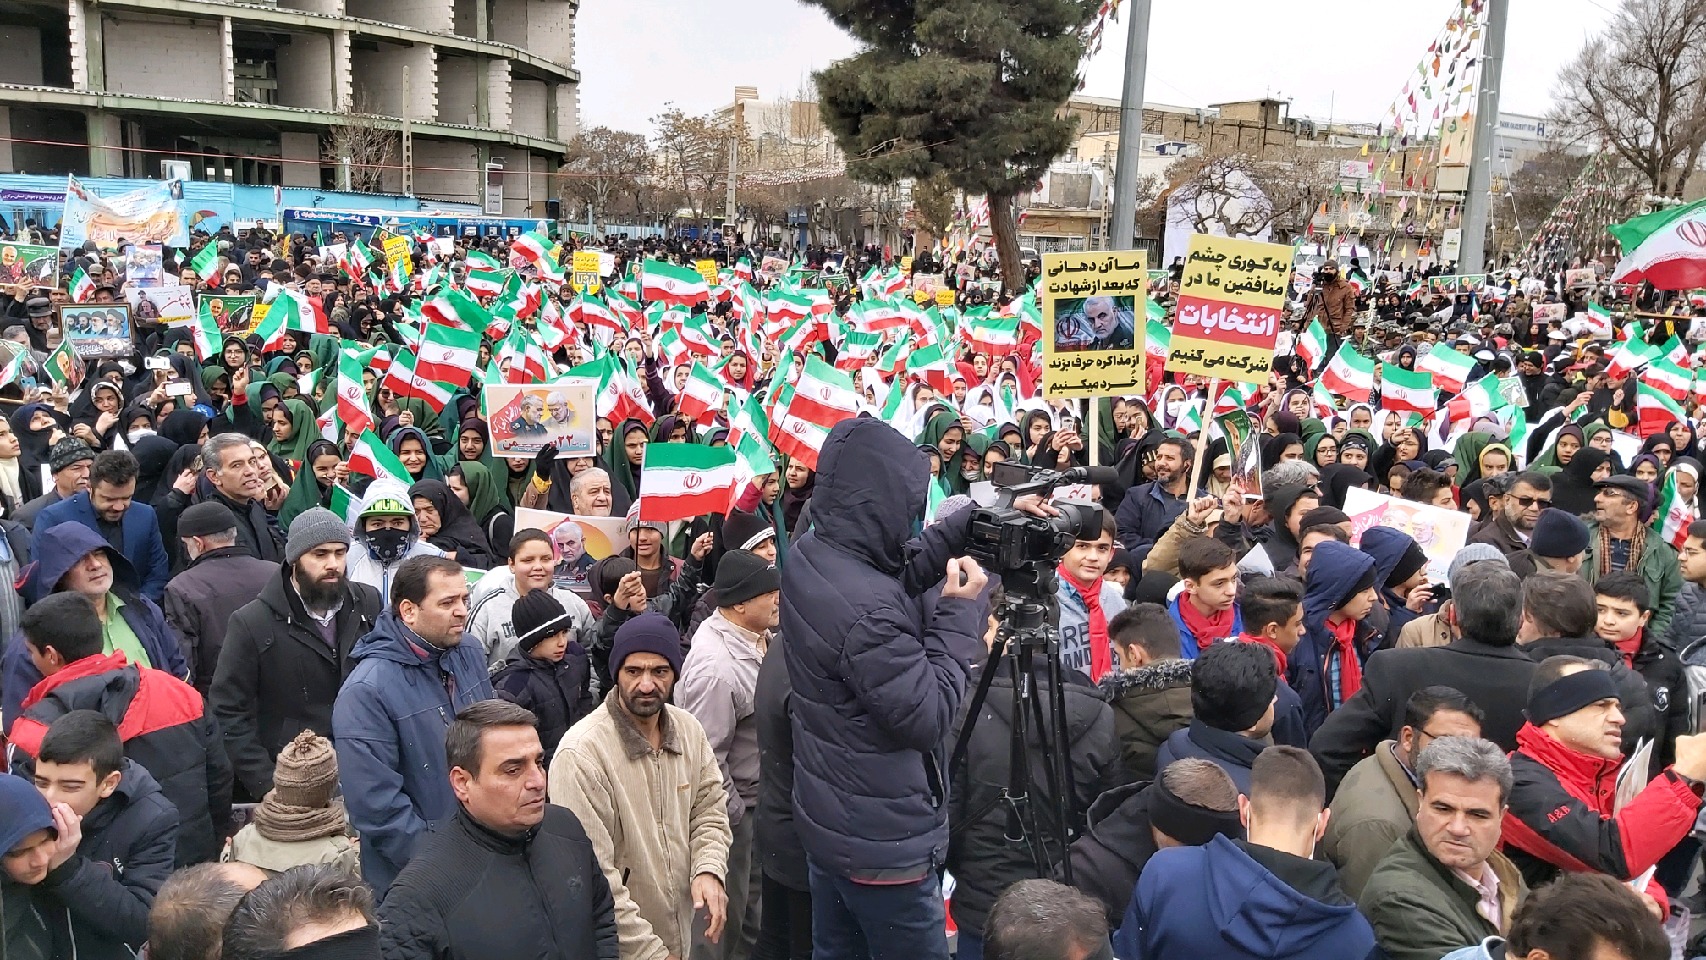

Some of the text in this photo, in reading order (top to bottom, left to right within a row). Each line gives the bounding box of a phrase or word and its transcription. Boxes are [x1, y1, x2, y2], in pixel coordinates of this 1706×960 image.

[1048, 257, 1140, 276] ما آن دهانی
[1188, 246, 1288, 277] به کوری چشم
[1049, 278, 1140, 295] که بعد از شهادت
[1184, 271, 1283, 296] منافقین ما در
[1178, 304, 1275, 336] انتخابات
[1049, 354, 1140, 371] از مذاکره حرف بزند
[1226, 355, 1269, 373] شرکت
[1546, 805, 1571, 824] A&B
